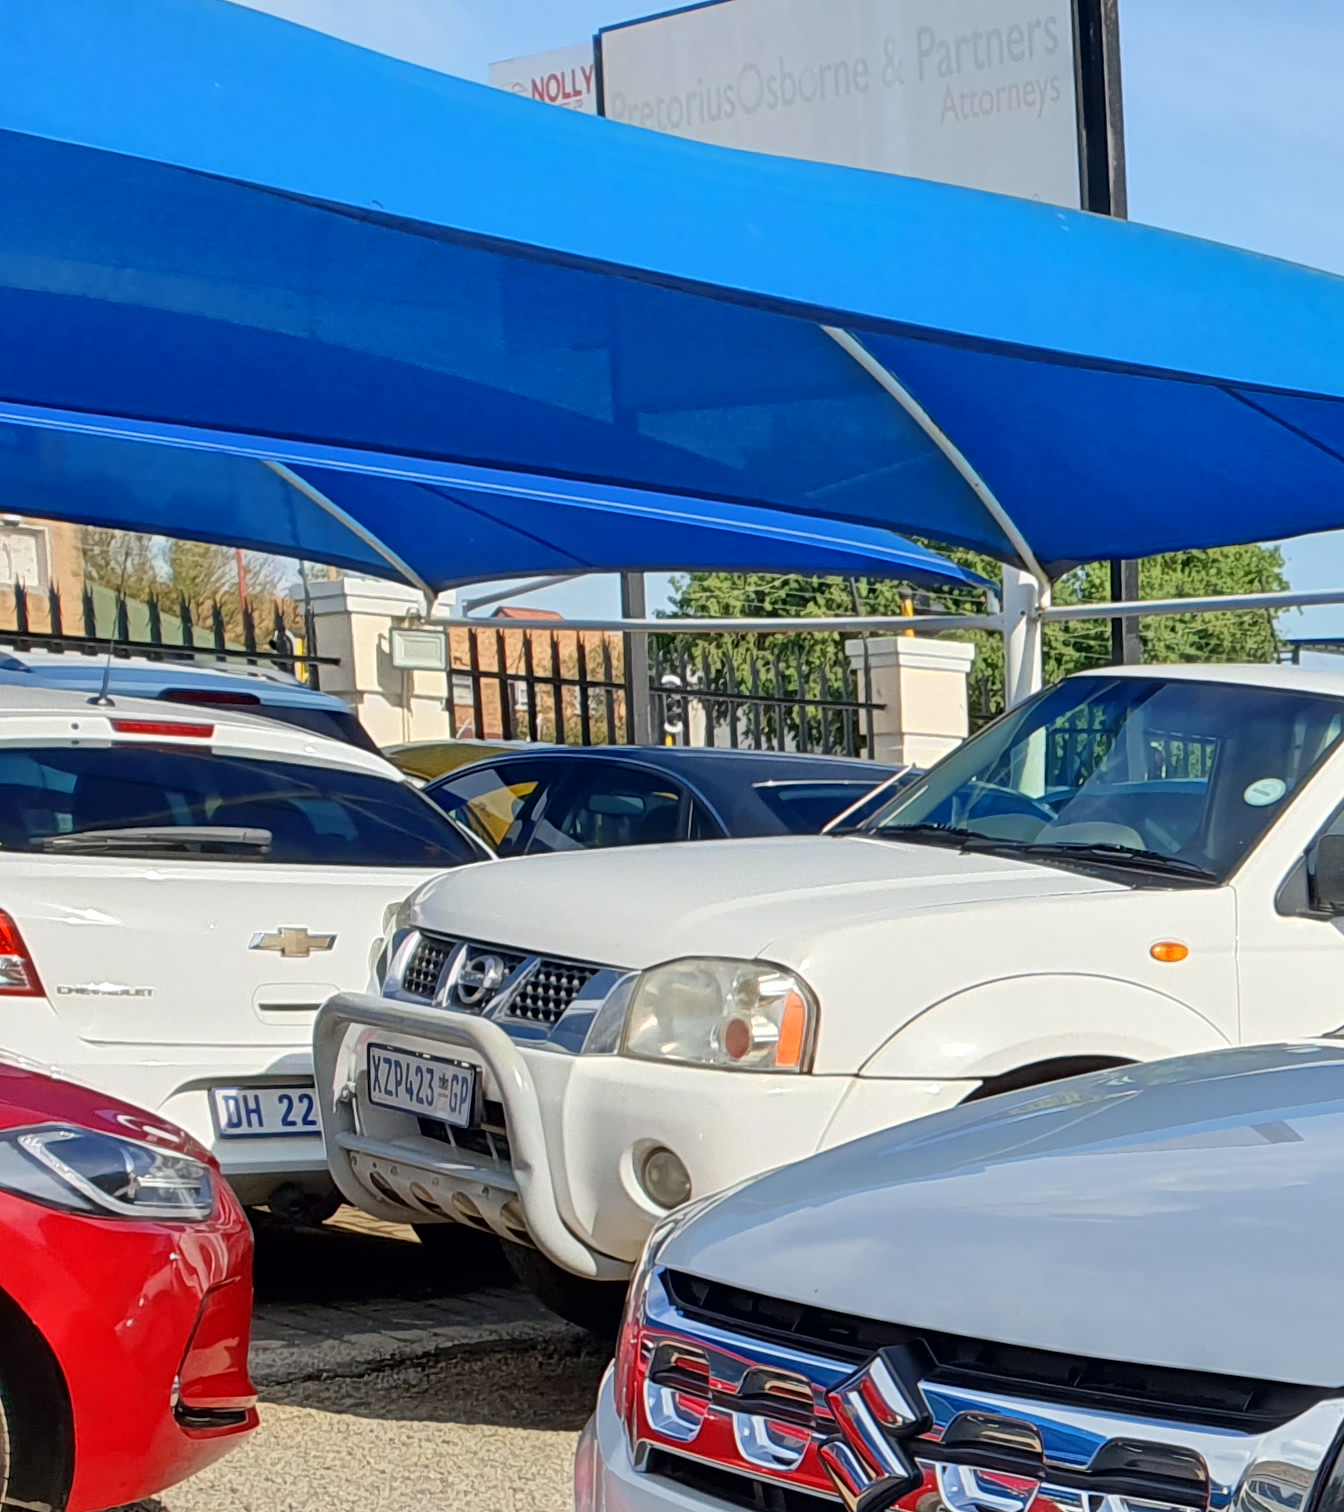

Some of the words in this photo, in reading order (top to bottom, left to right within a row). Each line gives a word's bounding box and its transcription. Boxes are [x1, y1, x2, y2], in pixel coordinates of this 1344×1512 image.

[882, 35, 905, 88] &
[916, 15, 1059, 82] Partners
[531, 64, 594, 103] NOLLY
[940, 76, 1061, 124] Attorneys
[372, 1054, 434, 1107] XZP423
[449, 1073, 469, 1115] GP
[222, 1094, 264, 1129] DH
[278, 1093, 318, 1127] 22
